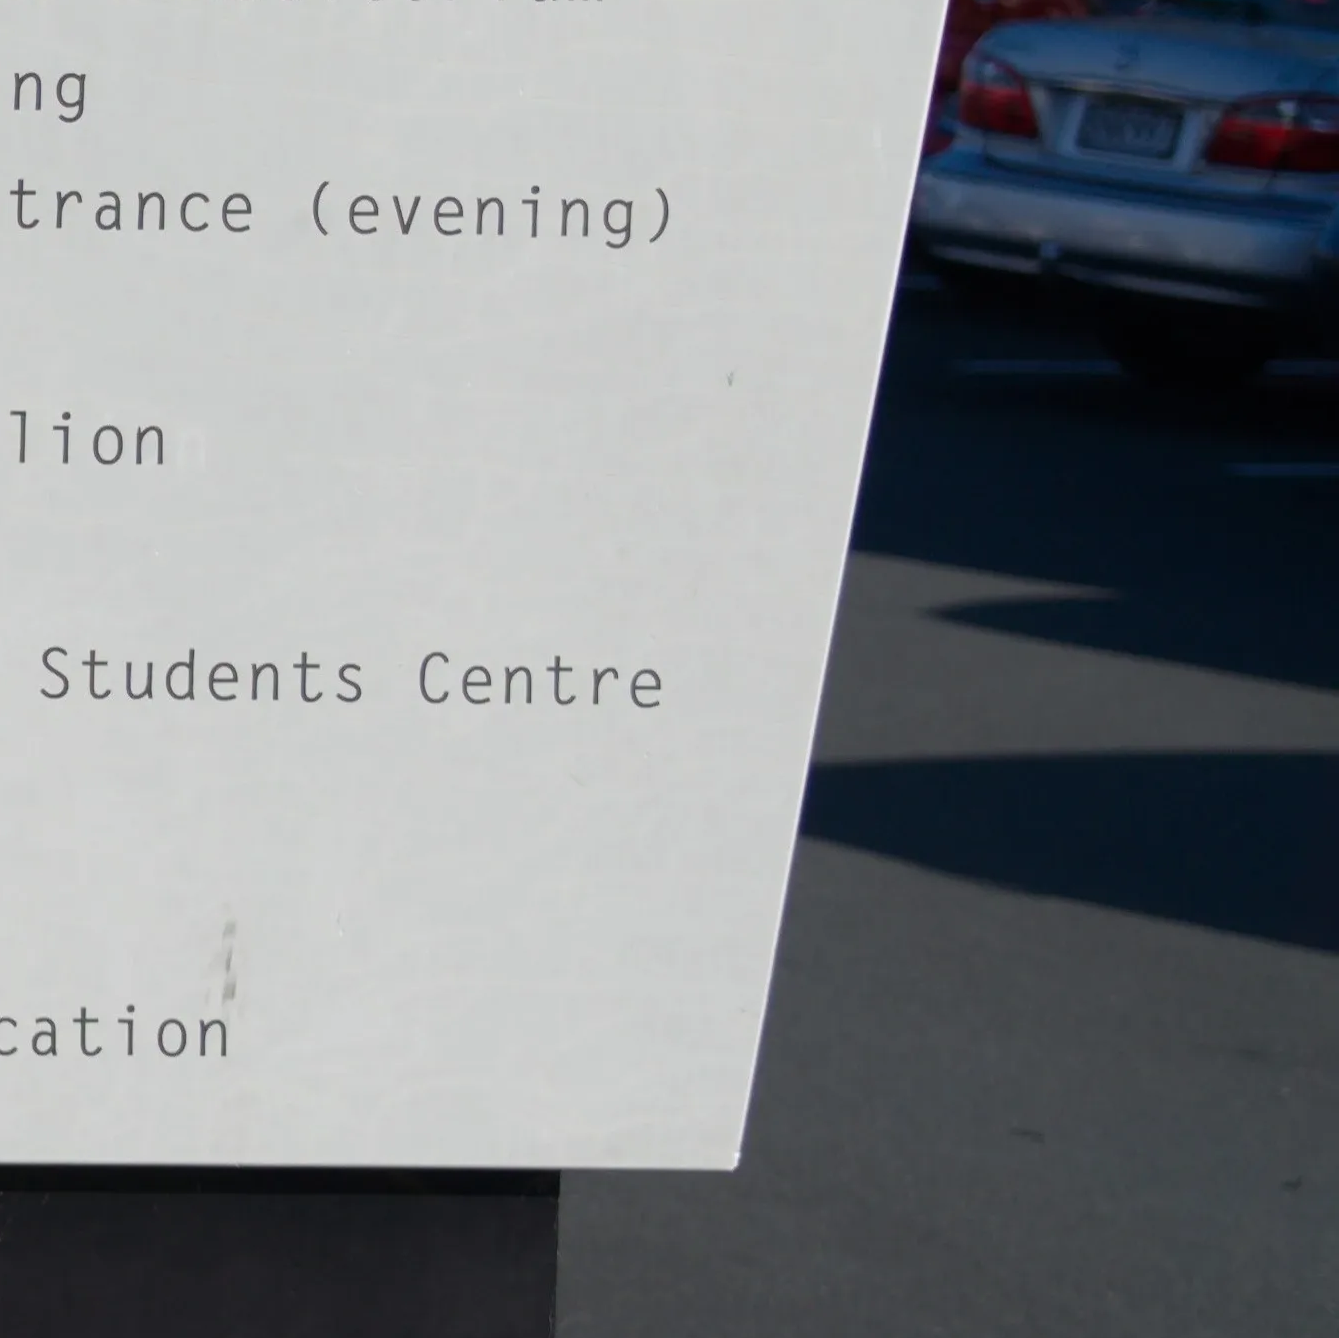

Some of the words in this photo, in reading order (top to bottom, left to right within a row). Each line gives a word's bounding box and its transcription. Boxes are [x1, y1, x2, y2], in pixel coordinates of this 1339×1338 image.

[313, 180, 670, 249] (evening)
[40, 646, 363, 703] Students
[419, 651, 663, 708] Centre
